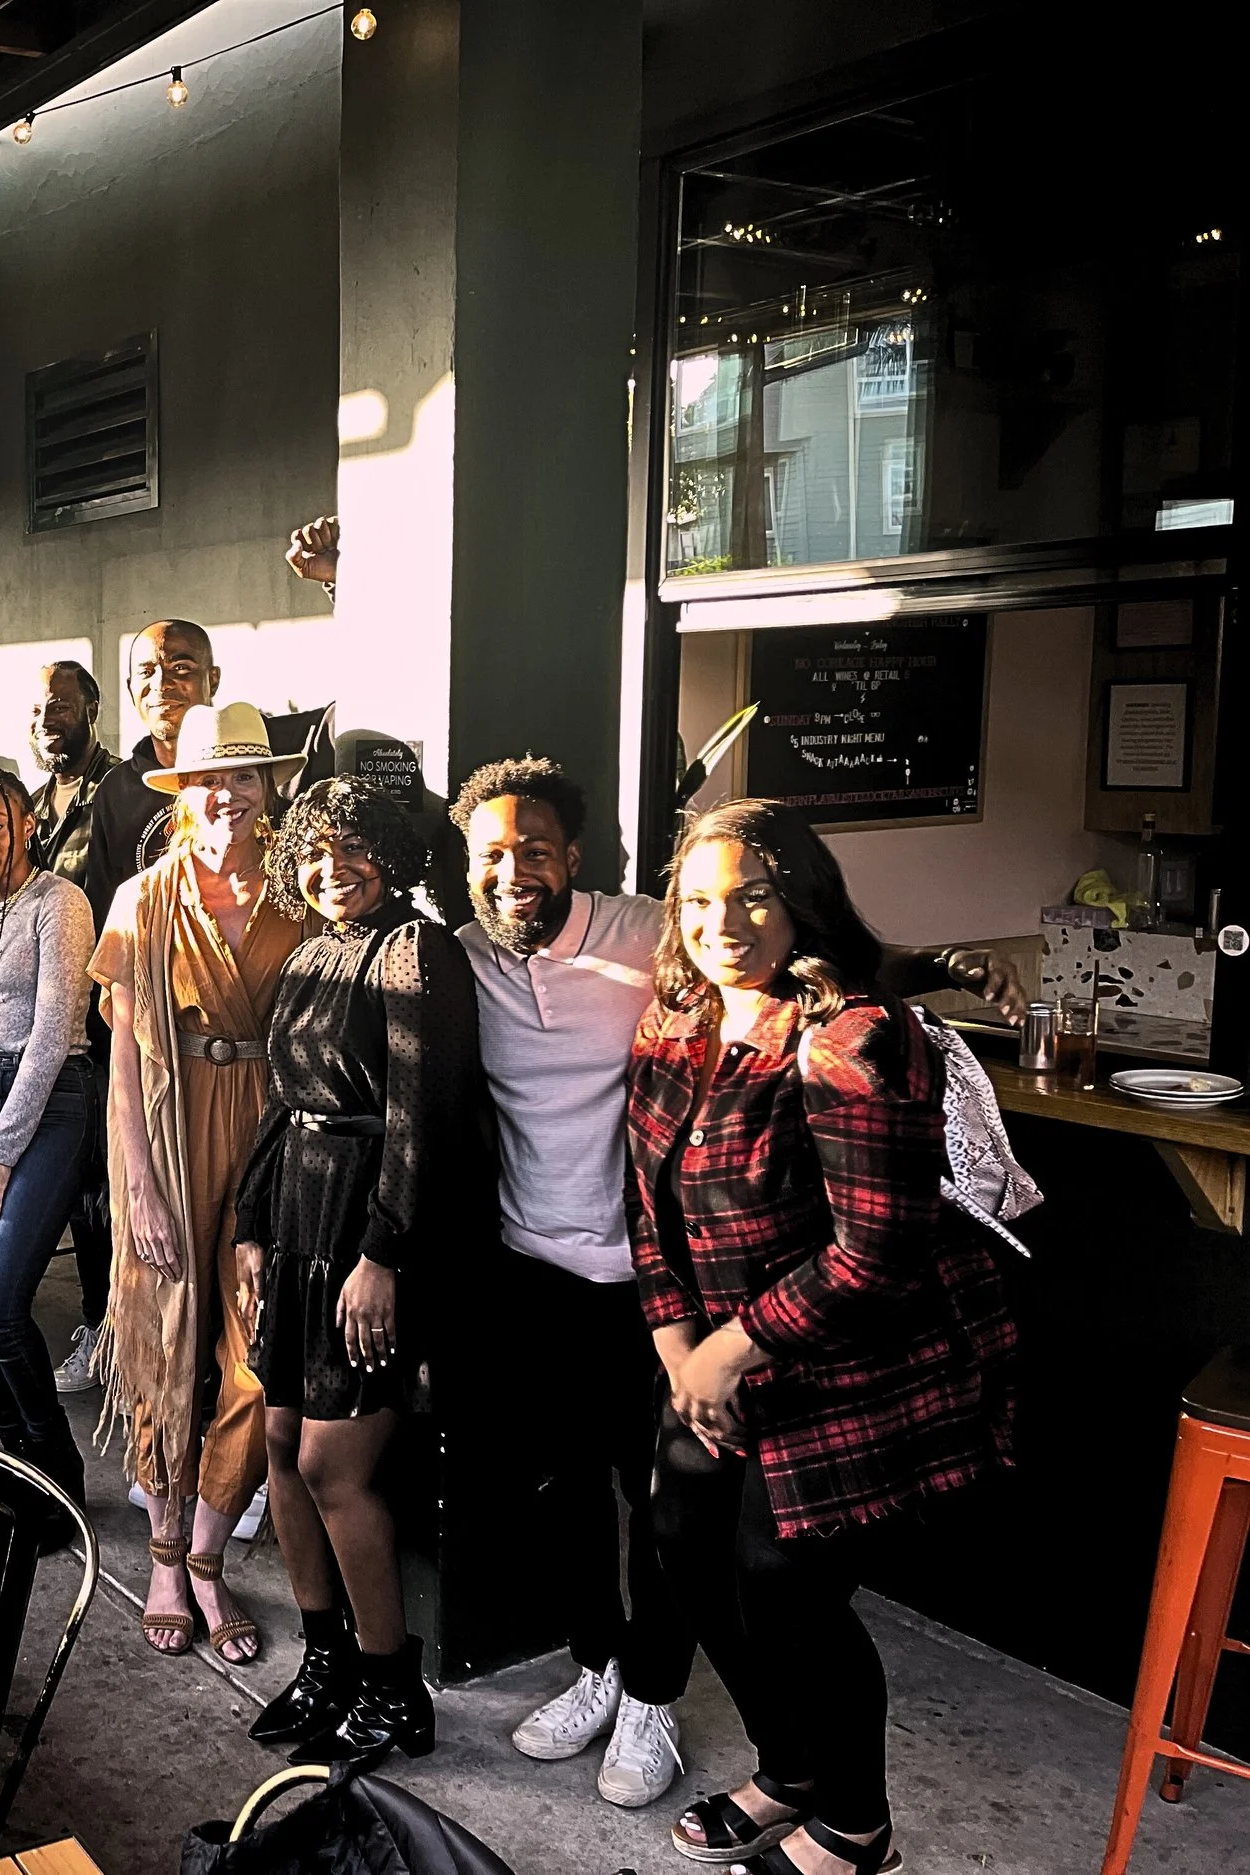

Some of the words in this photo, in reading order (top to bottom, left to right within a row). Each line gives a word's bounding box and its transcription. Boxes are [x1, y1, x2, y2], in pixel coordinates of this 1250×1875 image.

[812, 671, 828, 682] ALL
[835, 671, 858, 681] WINES
[874, 670, 900, 680] RETAIL
[864, 732, 885, 743] MENU
[373, 748, 403, 760] Absolutely
[802, 749, 823, 768] SNACK
[360, 761, 374, 772] NO
[375, 761, 417, 773] SMOKING
[378, 775, 412, 786] VAPING
